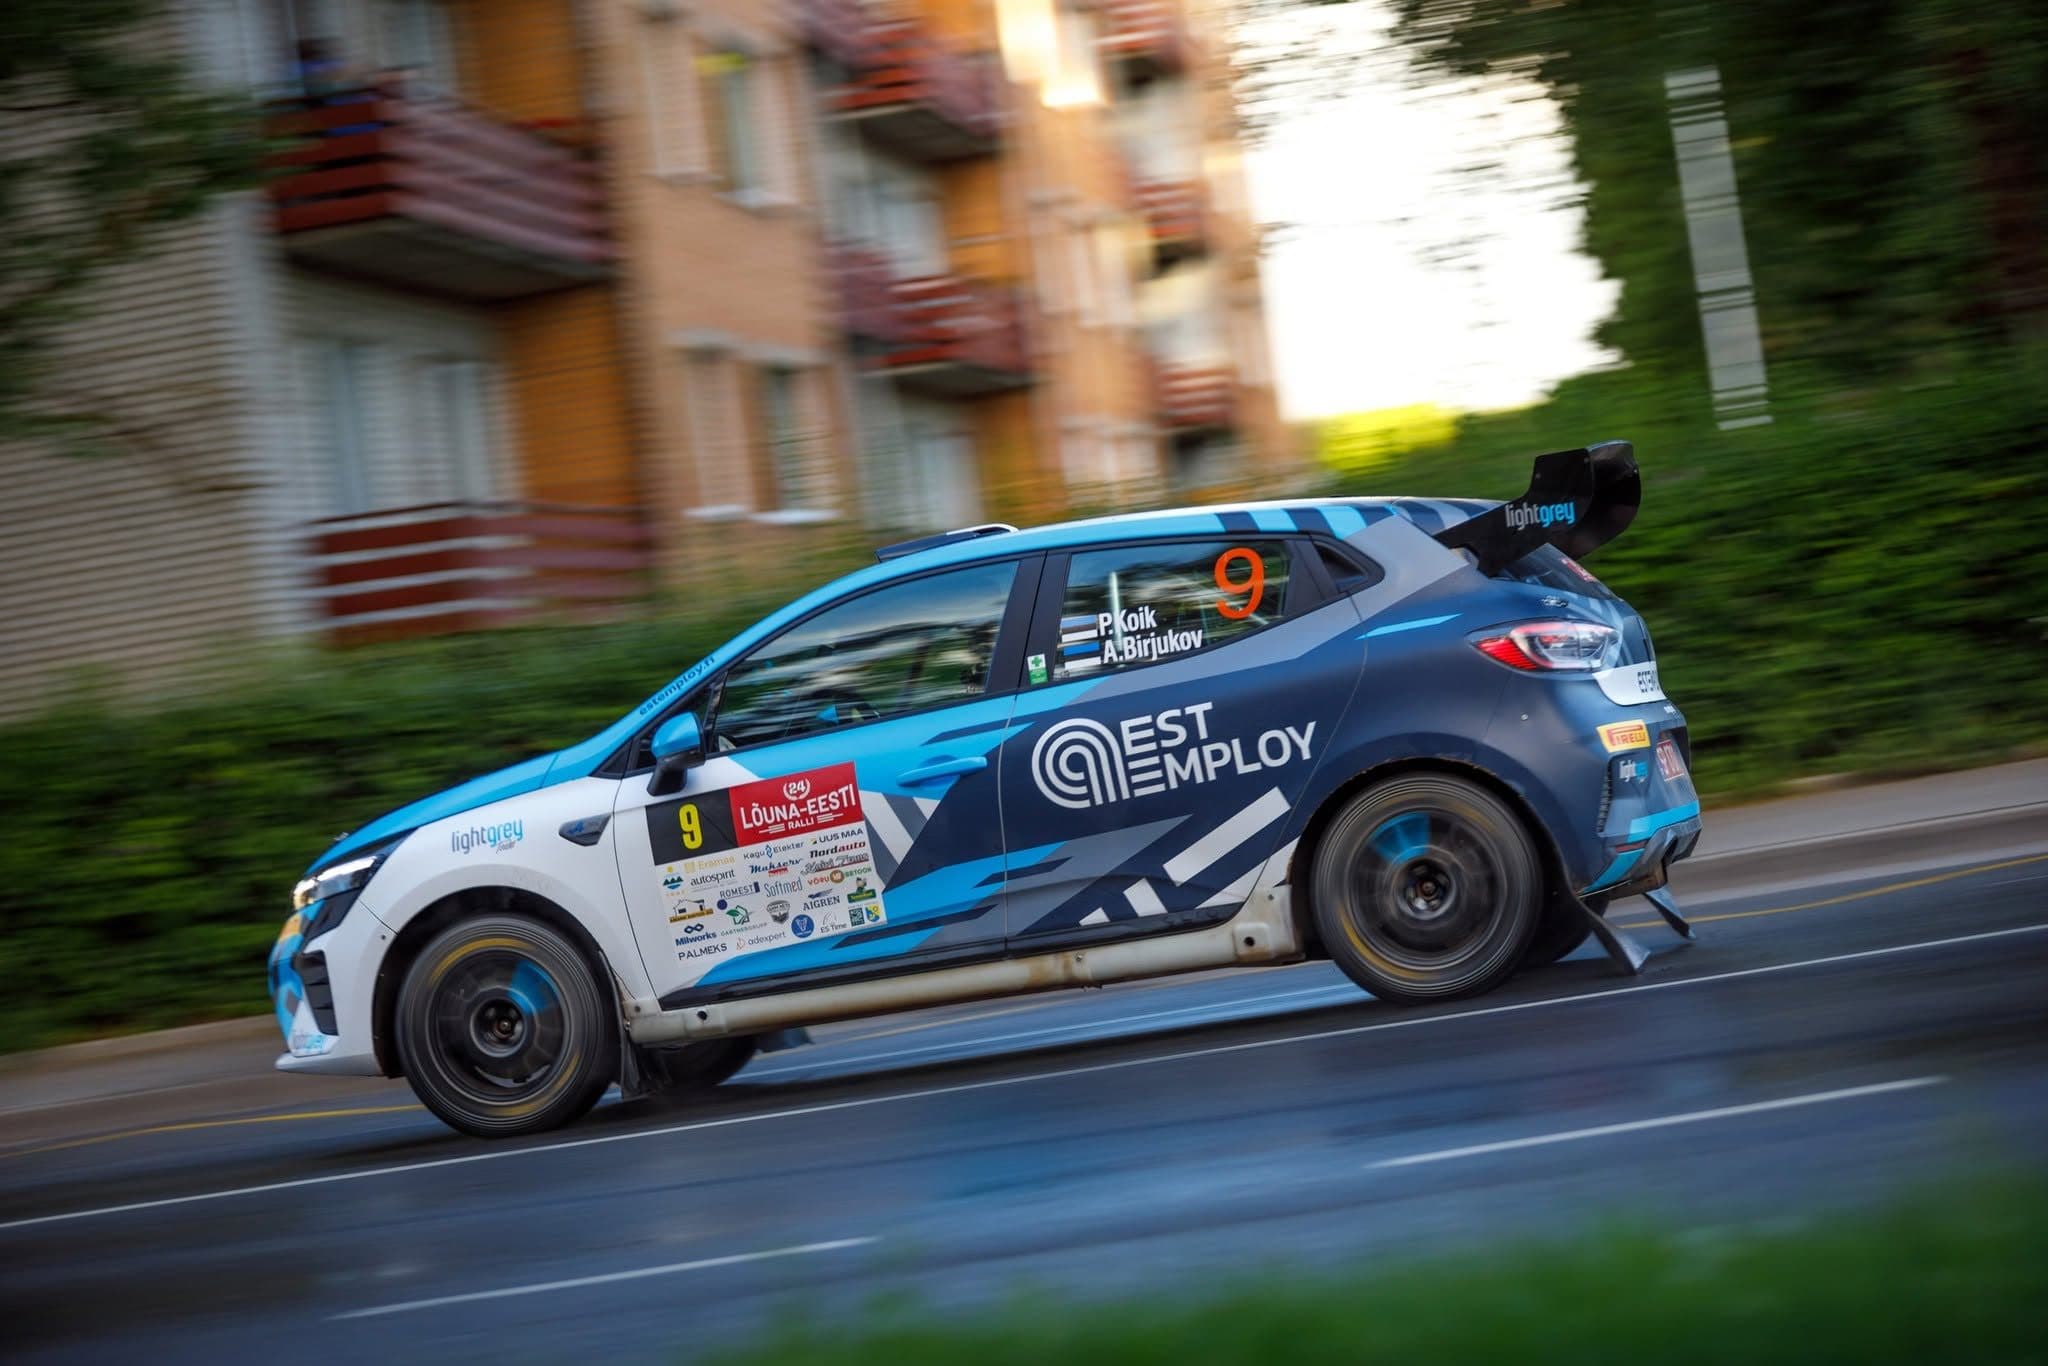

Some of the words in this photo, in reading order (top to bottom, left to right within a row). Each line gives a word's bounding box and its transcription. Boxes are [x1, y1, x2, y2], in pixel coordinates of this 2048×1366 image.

[1505, 501, 1576, 530] lightgrey
[1214, 546, 1265, 620] 9
[1099, 605, 1157, 636] P.Koik
[1103, 629, 1203, 664] A.Birjukov
[1120, 702, 1213, 756] EST
[1128, 721, 1317, 798] EMPLOY
[788, 780, 806, 795] 24
[740, 783, 856, 830] LÕUNA-EESTI
[678, 803, 703, 850] 9
[788, 816, 815, 830] RALLI
[451, 819, 523, 855] lightgrey
[818, 831, 840, 844] UUS
[841, 827, 864, 839] MAA
[690, 869, 735, 886] autospirit
[763, 876, 803, 898] Softmed
[719, 884, 754, 899] ROMEST
[802, 895, 841, 912] AIGREN
[675, 931, 718, 946] Milworks
[747, 930, 787, 947] adexpert
[678, 942, 728, 961] PALMEKS
